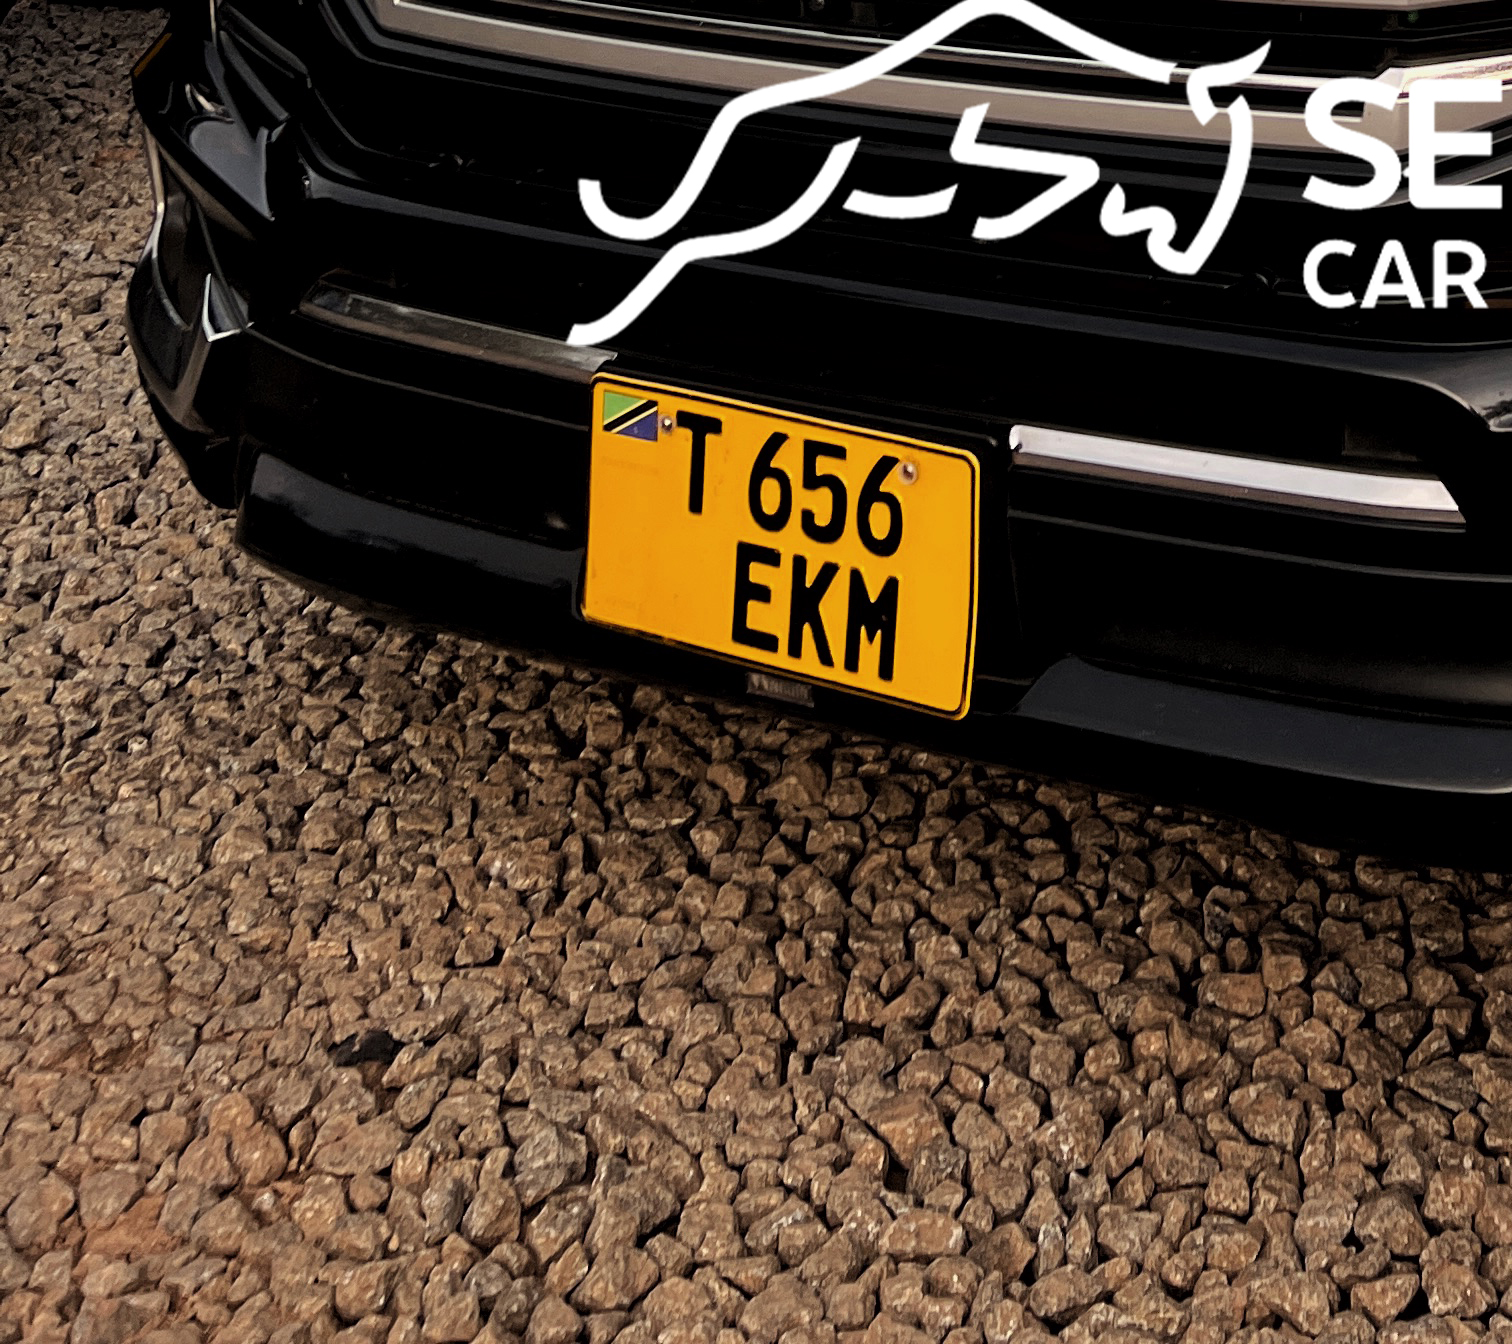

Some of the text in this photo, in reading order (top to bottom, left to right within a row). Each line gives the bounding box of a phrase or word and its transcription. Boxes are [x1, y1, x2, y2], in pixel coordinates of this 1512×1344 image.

[676, 410, 903, 557] T 656
[732, 541, 899, 682] EKM
